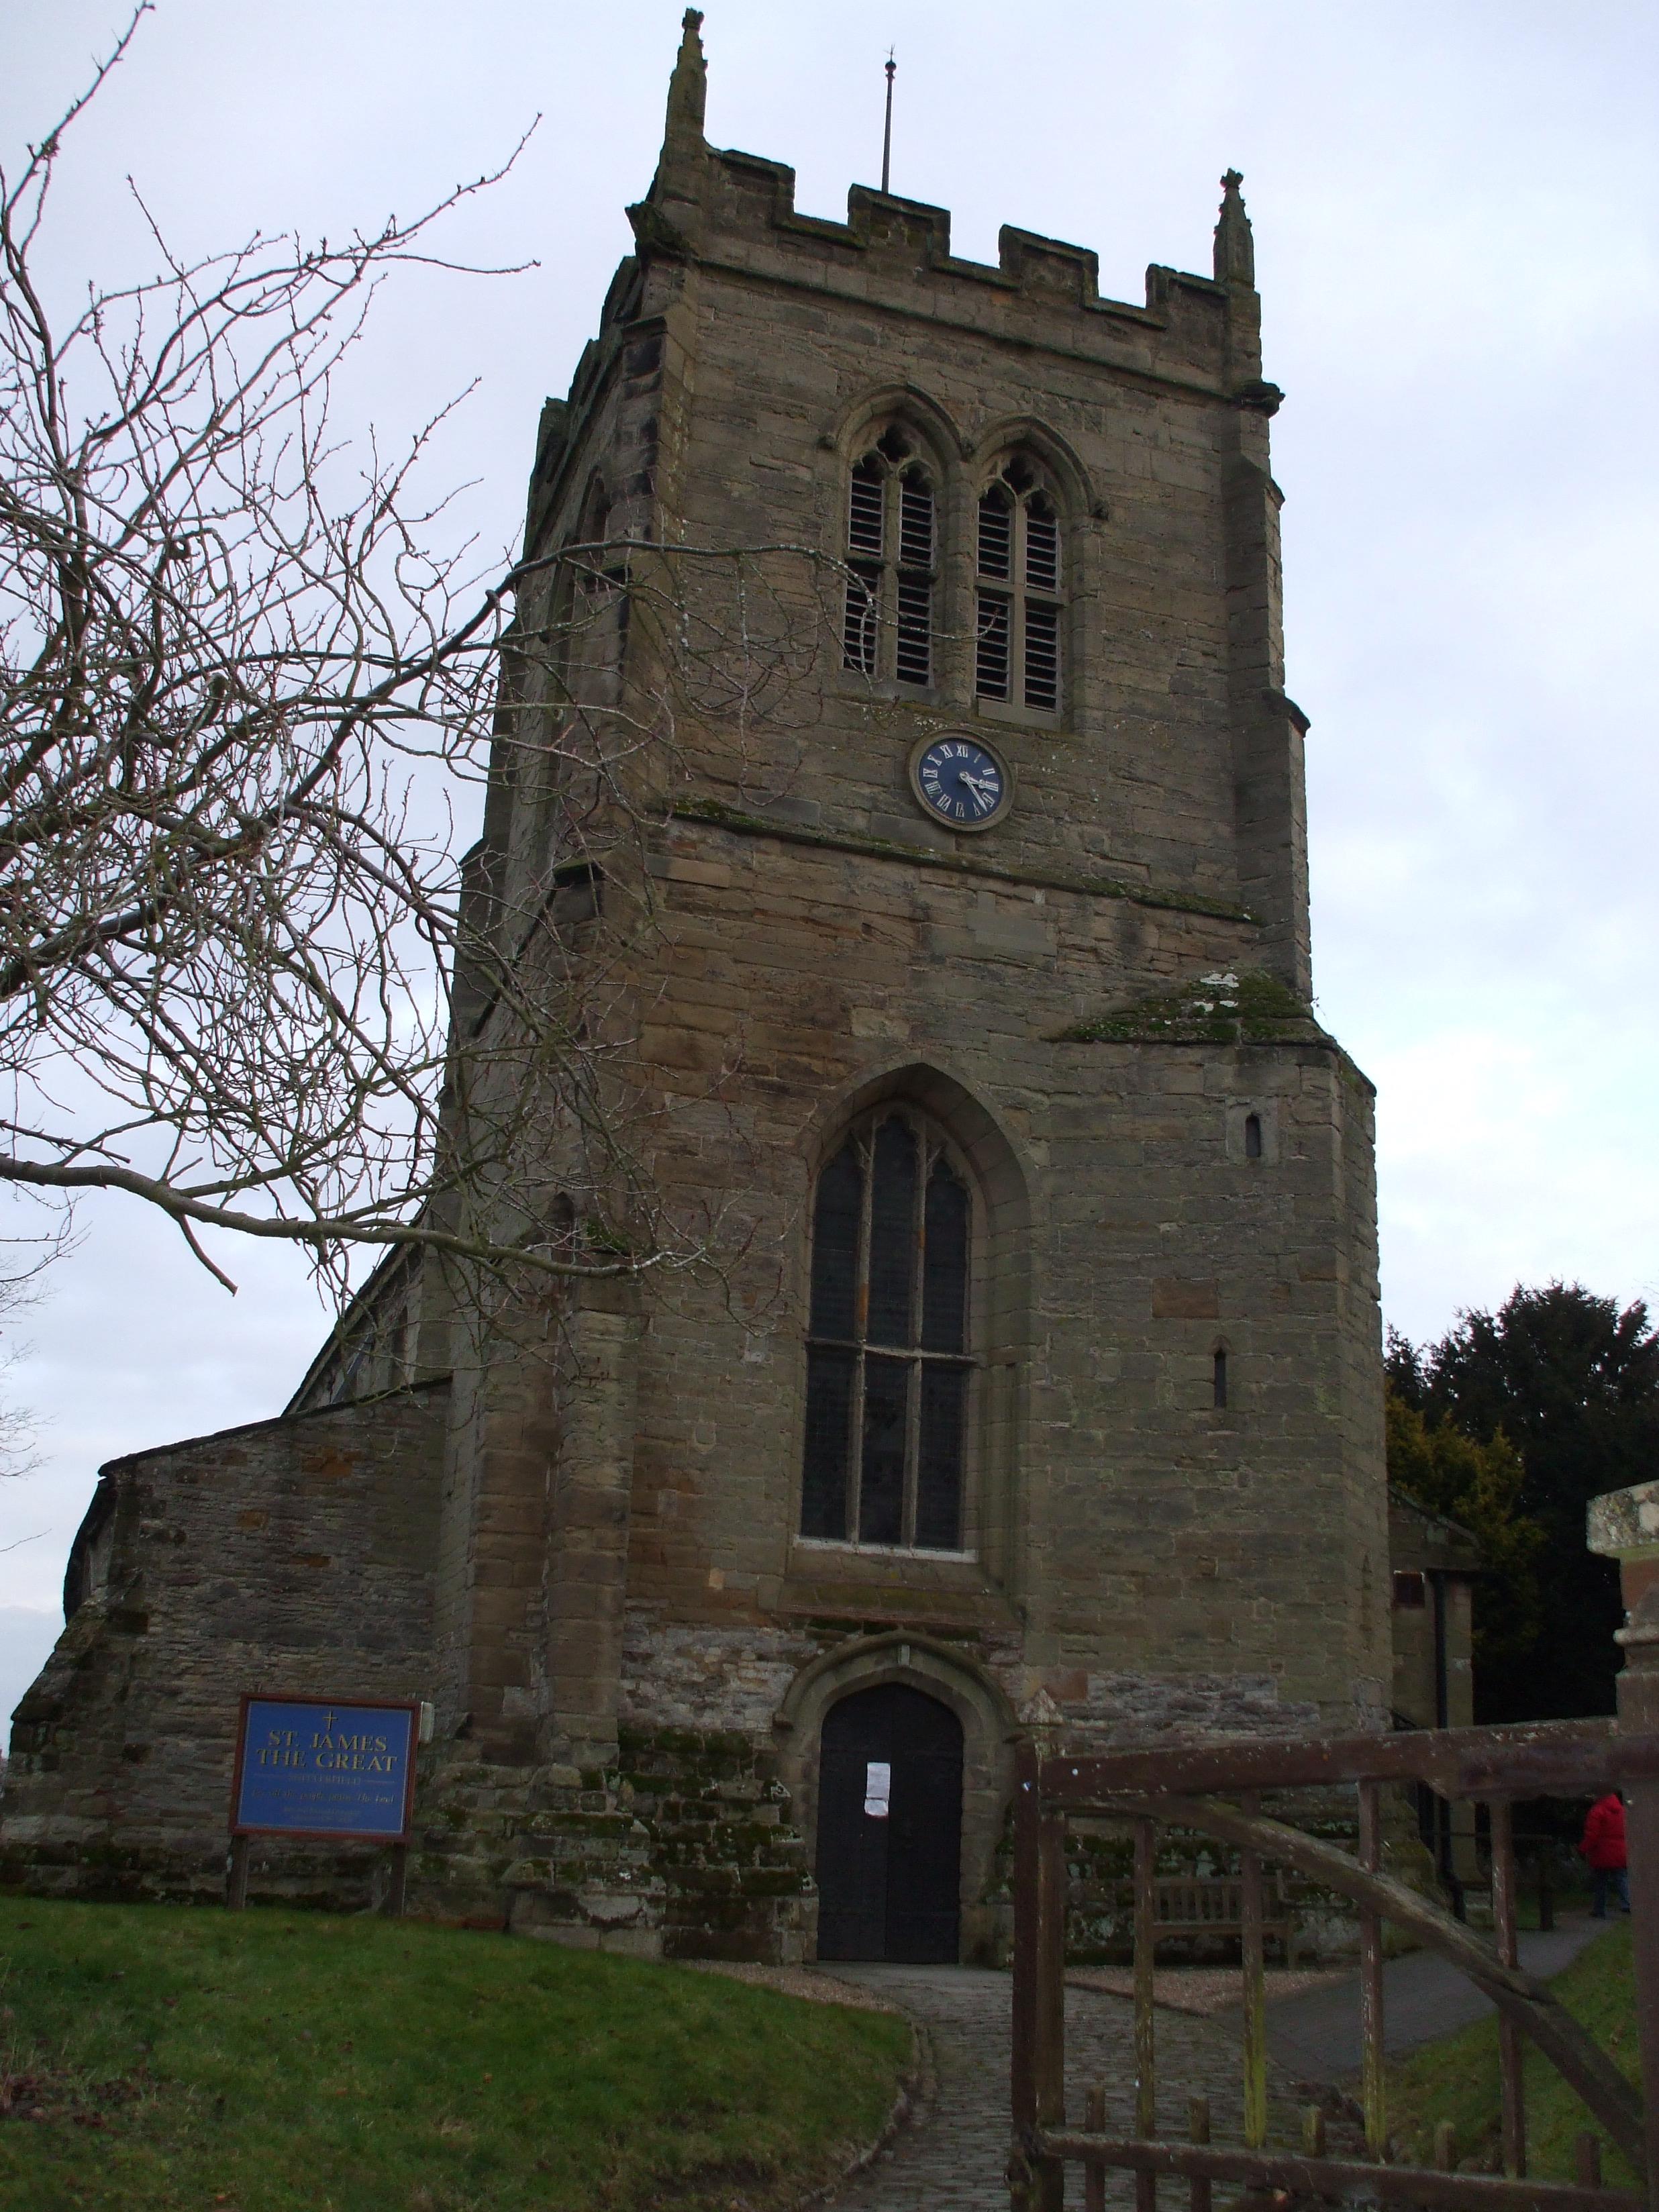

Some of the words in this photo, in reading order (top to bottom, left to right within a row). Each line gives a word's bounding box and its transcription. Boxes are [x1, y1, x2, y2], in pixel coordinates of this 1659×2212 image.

[956, 745, 968, 758] XII
[268, 1729, 300, 1747] ST.
[310, 1732, 387, 1752] JAMES
[257, 1748, 307, 1767] THE
[315, 1752, 397, 1772] GREAT
